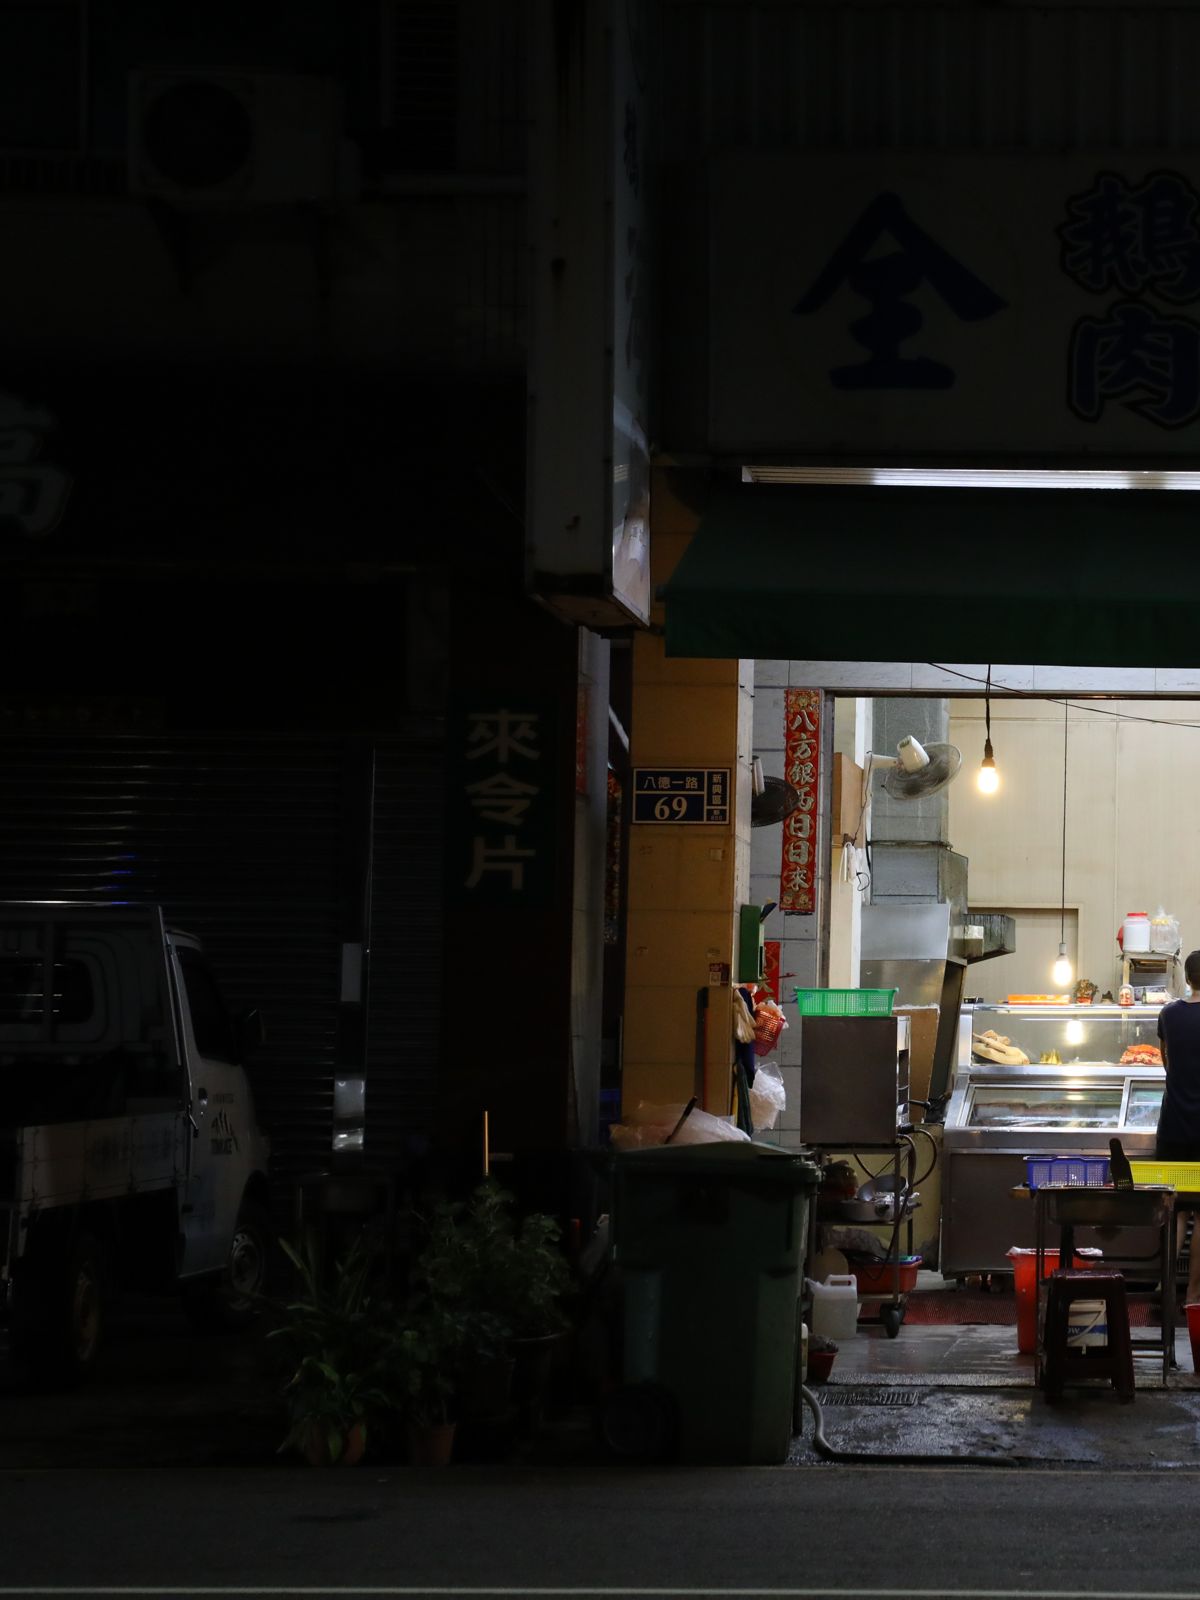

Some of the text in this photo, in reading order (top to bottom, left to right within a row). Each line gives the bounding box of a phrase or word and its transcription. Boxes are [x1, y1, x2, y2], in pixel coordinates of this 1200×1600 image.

[464, 708, 542, 890] 來令片
[654, 797, 688, 820] 69
